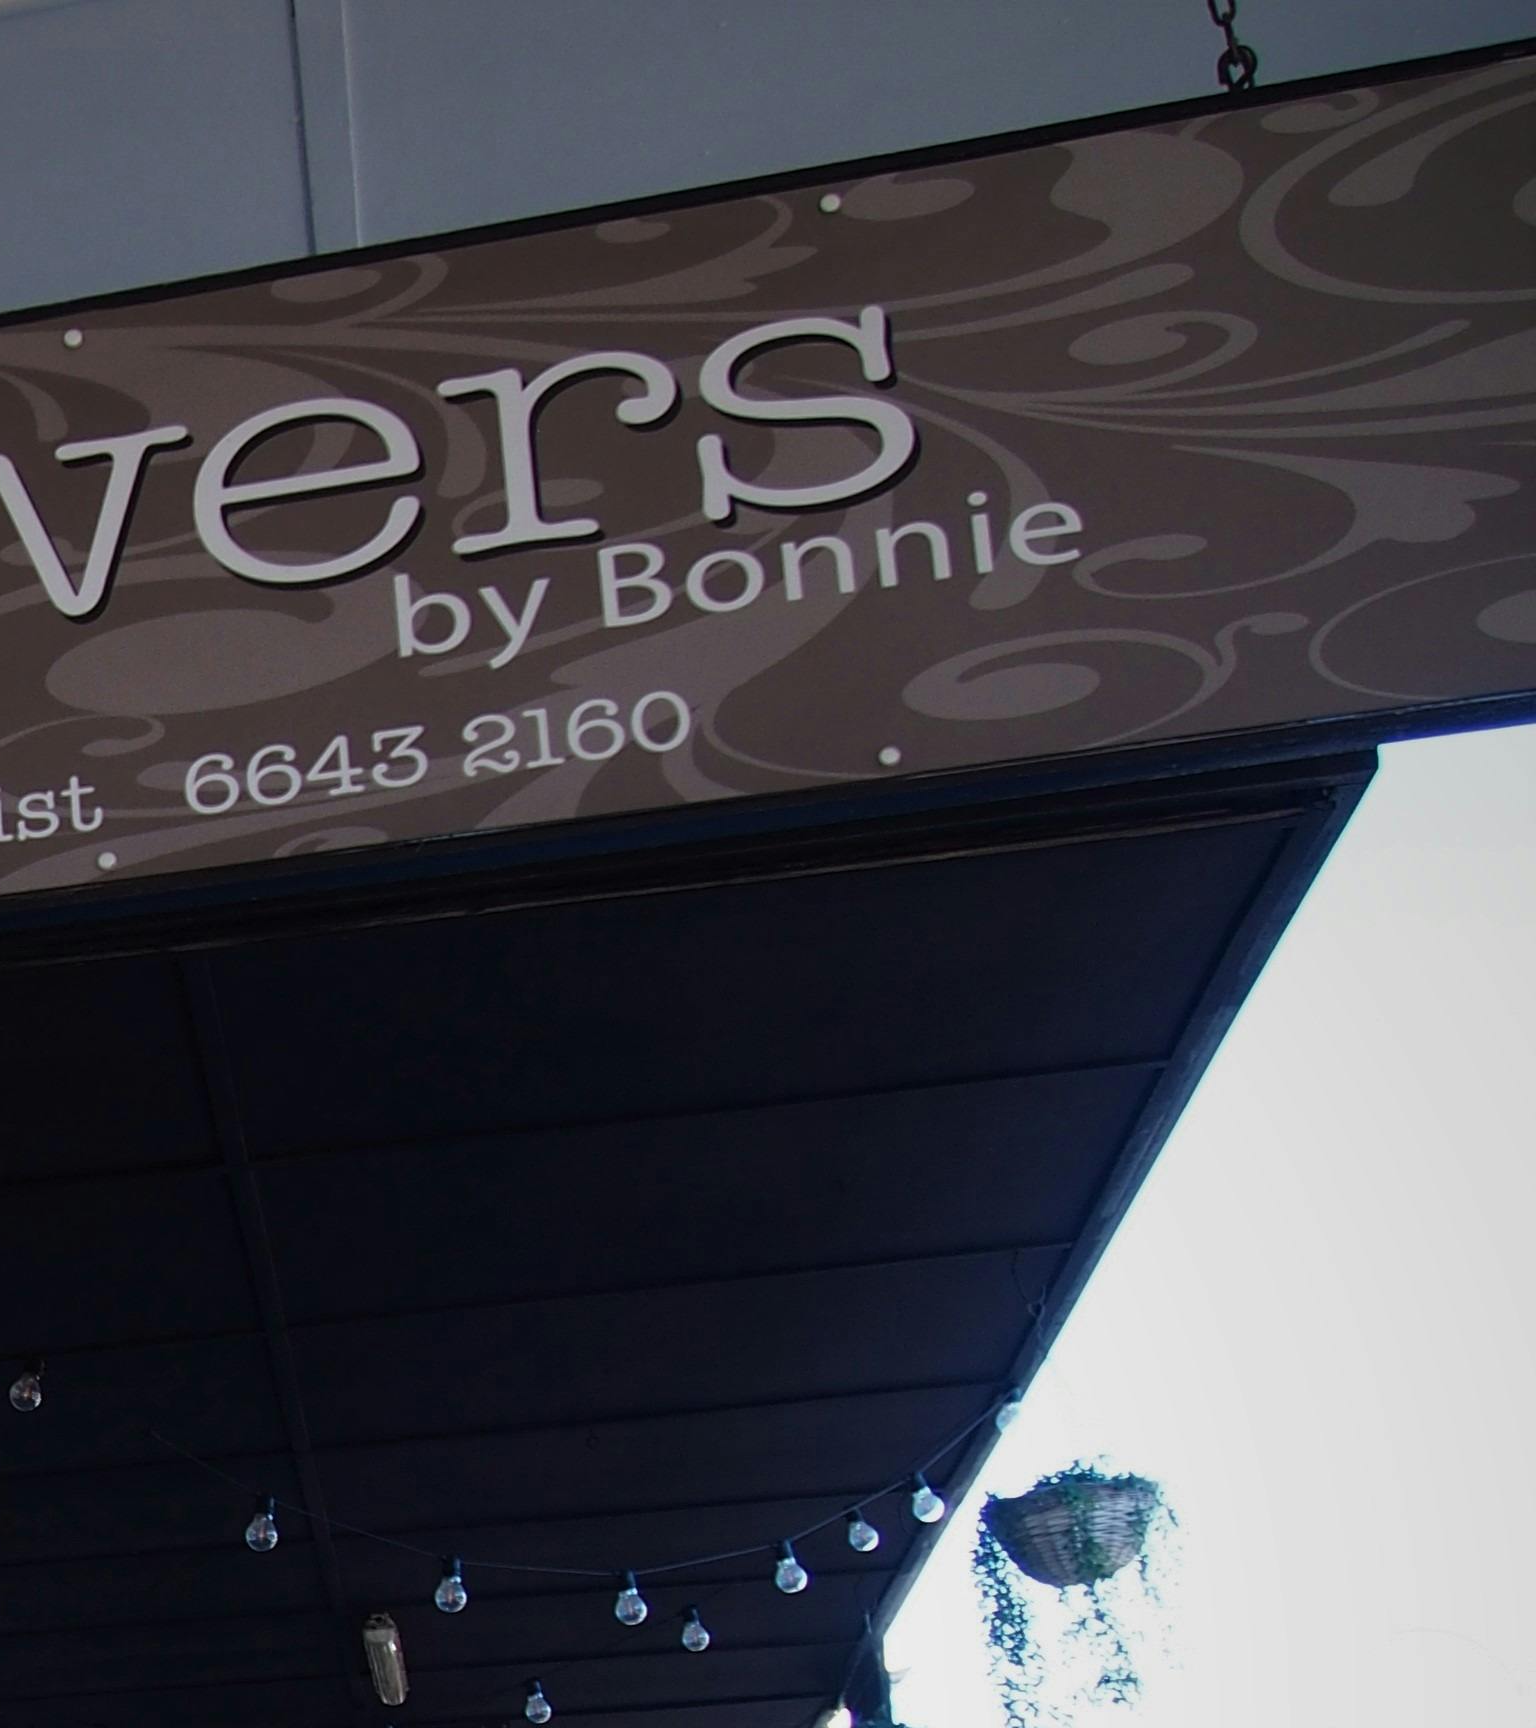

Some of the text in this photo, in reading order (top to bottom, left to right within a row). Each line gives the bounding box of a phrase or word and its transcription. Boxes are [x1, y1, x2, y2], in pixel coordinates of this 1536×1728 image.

[393, 491, 1084, 670] by Bonnie
[184, 724, 430, 815] 6643
[460, 689, 692, 778] 2160
